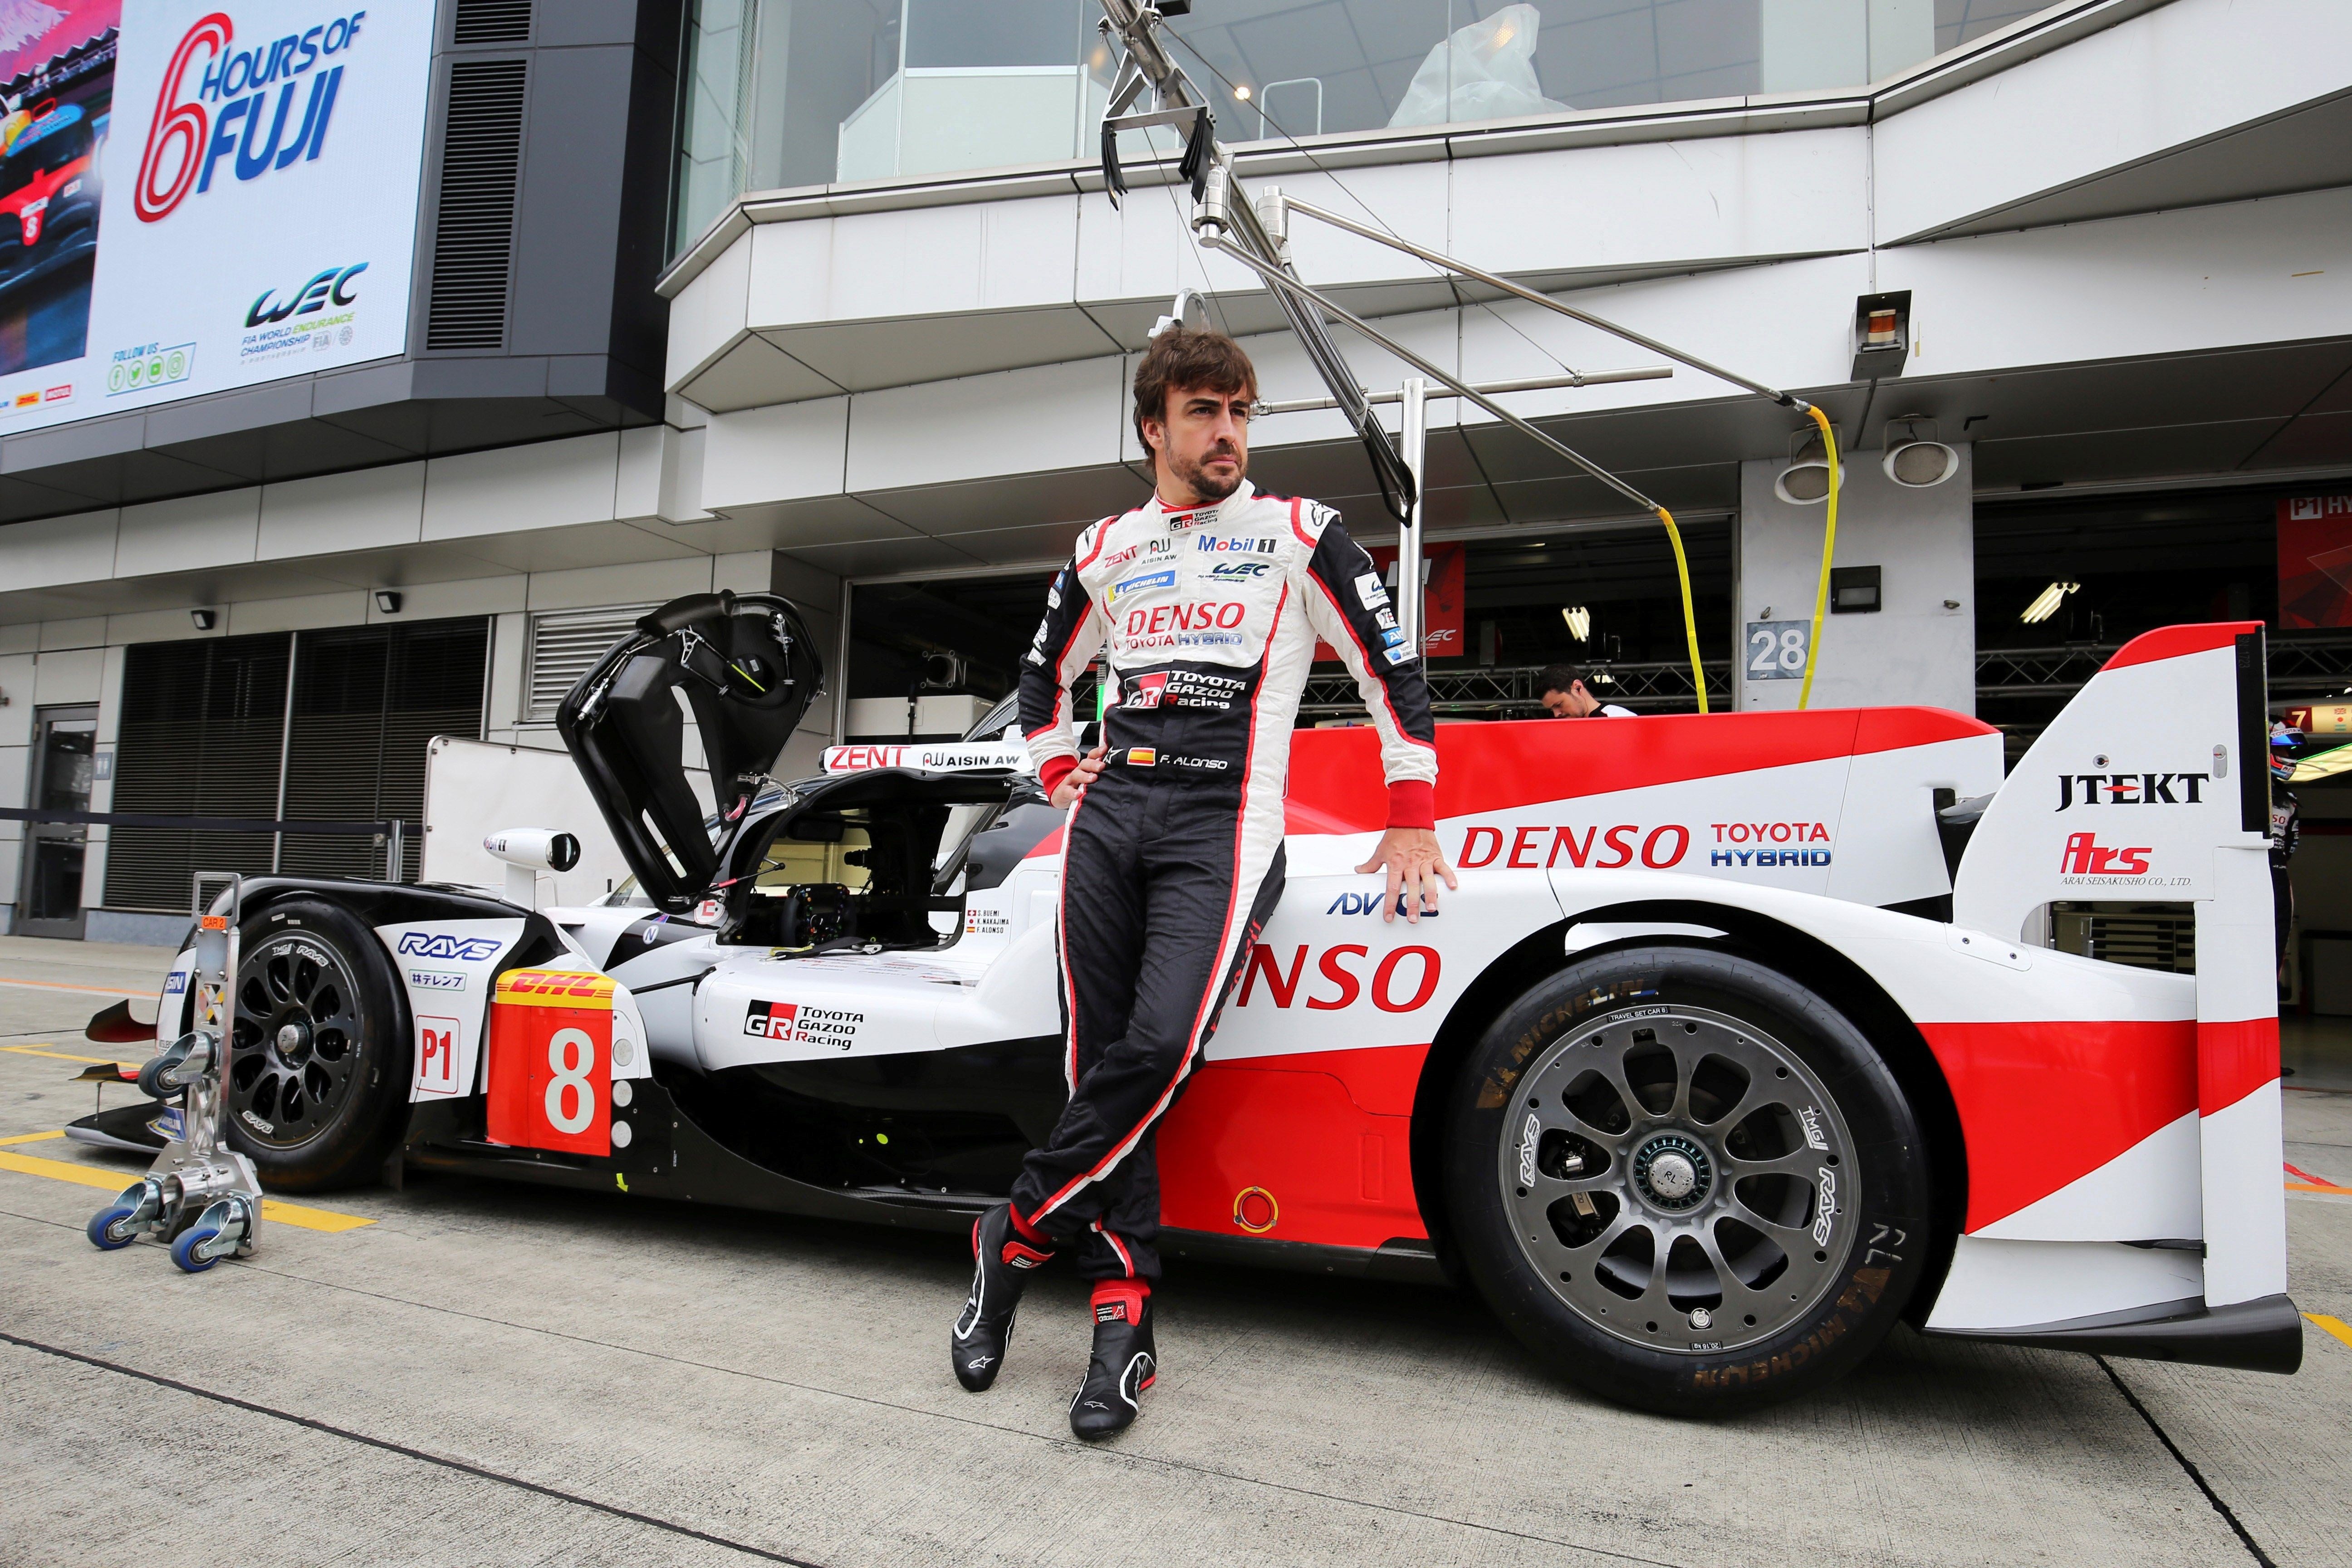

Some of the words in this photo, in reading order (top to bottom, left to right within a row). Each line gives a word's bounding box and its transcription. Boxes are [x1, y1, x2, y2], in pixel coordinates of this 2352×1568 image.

[199, 24, 323, 103] HOURS
[323, 10, 366, 55] OF
[134, 12, 233, 223] 6
[196, 65, 344, 195] FUJI
[244, 261, 369, 328] WEC
[242, 334, 257, 345] FIA
[259, 327, 292, 341] WORLD
[292, 312, 355, 334] ENDURANCE
[113, 345, 147, 362] FOLLOW
[147, 342, 159, 354] US
[240, 333, 311, 357] CHAMPIONSHIP
[1198, 534, 1254, 553] Mobil
[1104, 546, 1137, 568] ZENT
[1142, 556, 1162, 565] AISIN
[1212, 563, 1270, 577] WEC
[1125, 574, 1169, 592] MICHELIN
[1126, 602, 1245, 637] DENSO
[1126, 635, 1175, 650] TOYOTA
[1178, 632, 1243, 646] HYBRID
[1749, 628, 1806, 671] 28
[1165, 682, 1234, 699] GAZOO
[1171, 670, 1247, 691] TOYOTA
[1164, 696, 1230, 710] Racing
[2292, 710, 2306, 728] 7
[830, 746, 911, 769] ZENT
[946, 755, 990, 766] AISIN
[995, 755, 1021, 764] AW
[1159, 755, 1170, 764] F.
[1174, 756, 1228, 769] ALONSO
[2055, 773, 2210, 812] JTEKT
[1710, 823, 1830, 843] TOYOTA
[1456, 825, 1690, 868] DENSO
[1710, 848, 1832, 867] HYBRID
[2060, 877, 2084, 885] ARAI
[2087, 877, 2146, 886] SEISAKUSHO
[2148, 877, 2167, 887] CO.,
[2170, 877, 2192, 886] LTD.
[204, 917, 218, 927] CAR
[219, 919, 224, 928] 2
[296, 945, 329, 967] RAYS
[398, 932, 502, 961] RAYS
[412, 974, 463, 988] 林テレンプ
[509, 973, 599, 997] DHL
[1236, 944, 1441, 1013] NSO
[801, 1006, 864, 1023] TOYOTA
[1611, 1012, 1634, 1021] TRAVEL
[798, 1019, 856, 1035] GAZOO
[795, 1031, 853, 1051] Racing
[421, 1029, 451, 1080] P1
[544, 1027, 595, 1134] 8
[1519, 1113, 1540, 1187] RAYS
[1664, 1171, 1676, 1184] RL
[1813, 1166, 1836, 1247] RAYS
